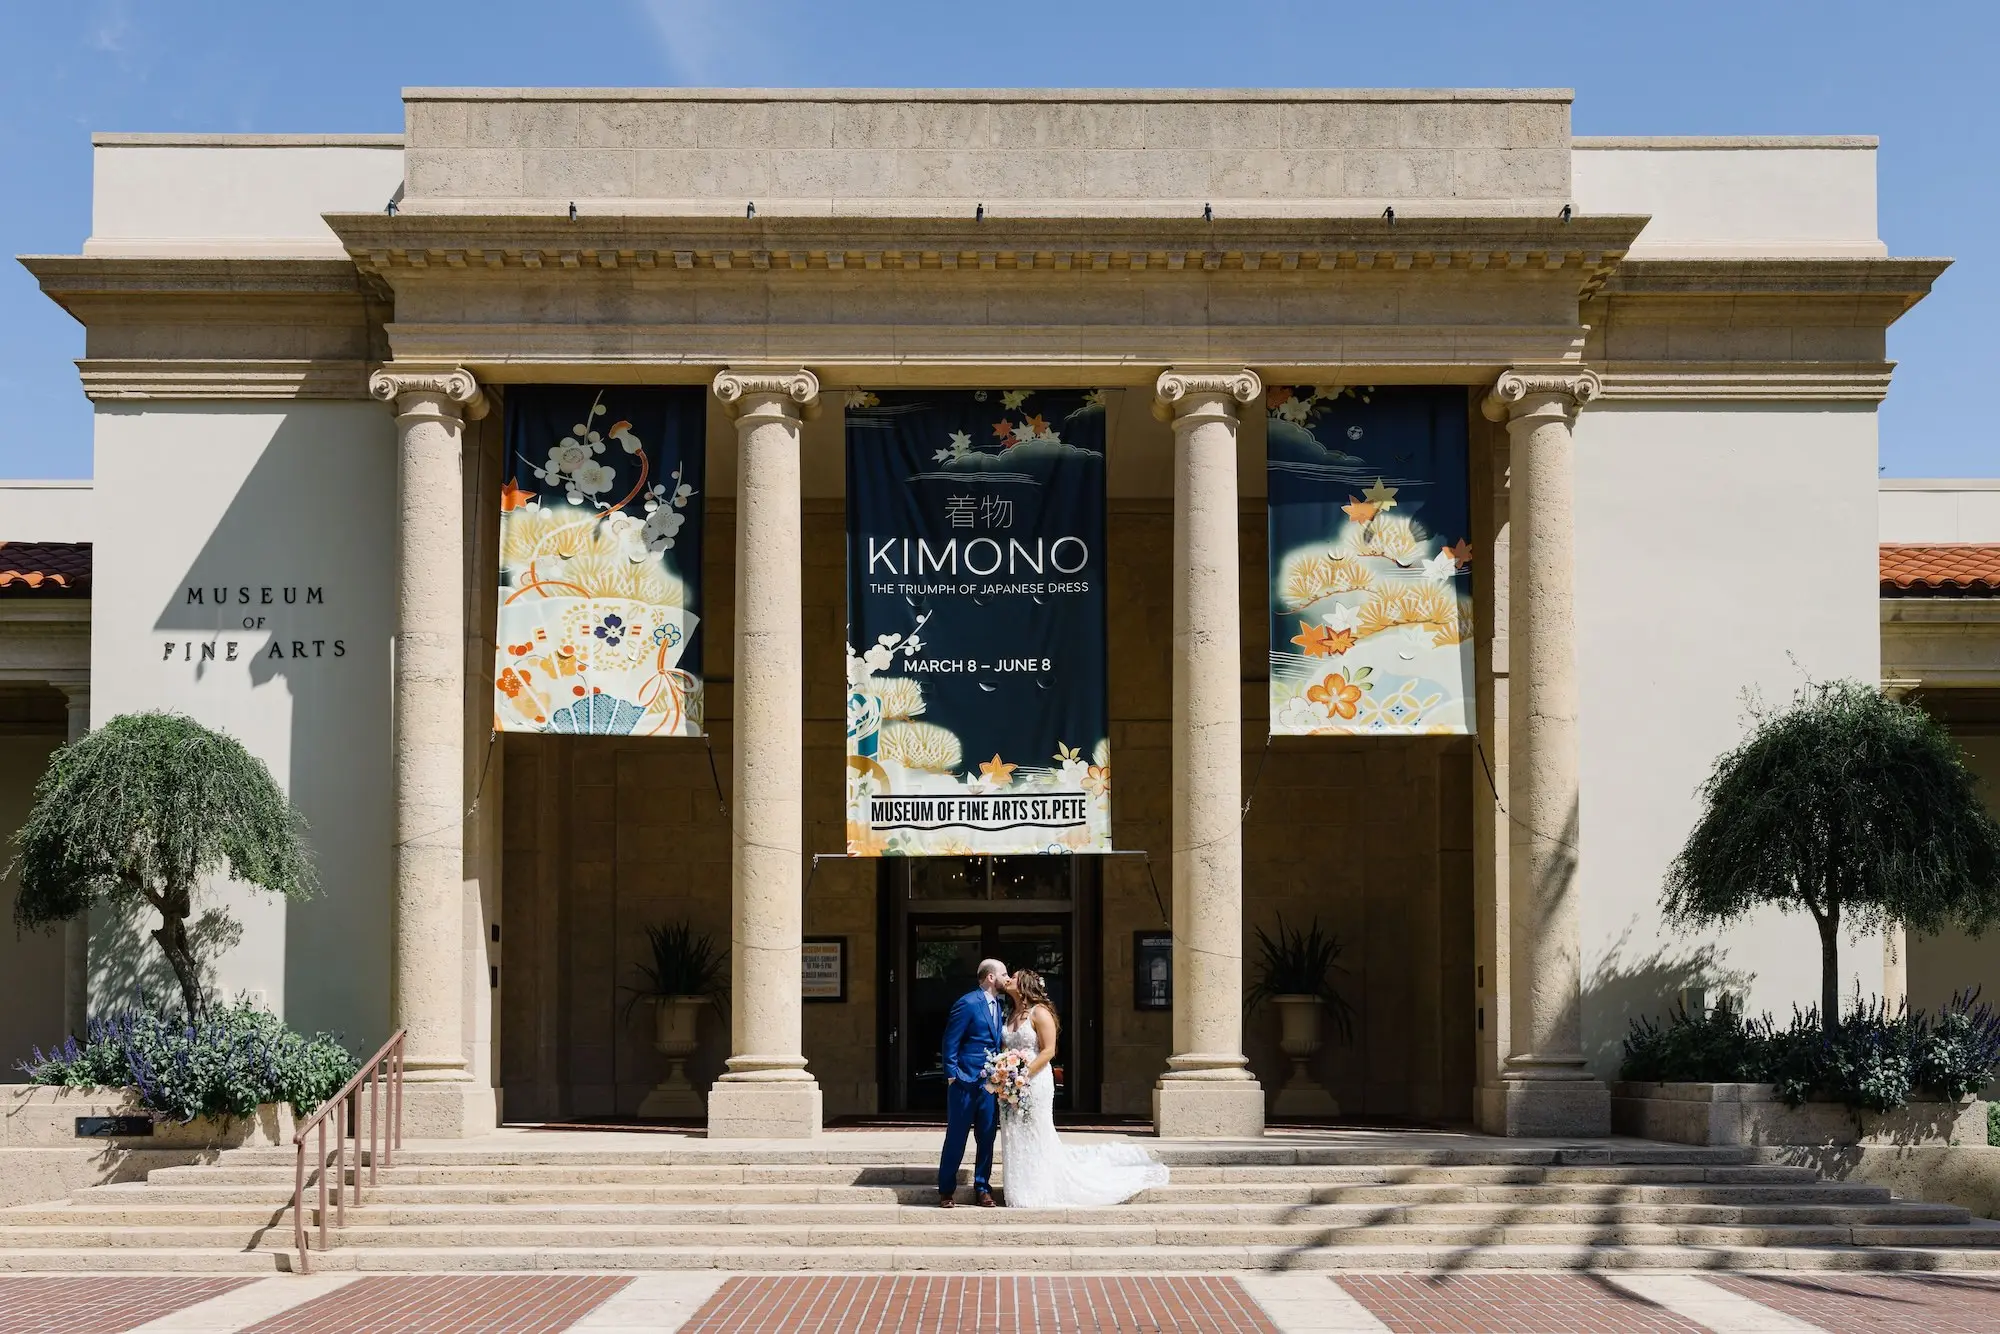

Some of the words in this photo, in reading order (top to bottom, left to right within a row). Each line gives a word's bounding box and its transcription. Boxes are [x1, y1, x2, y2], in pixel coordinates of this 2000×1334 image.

[945, 494, 1013, 529] 着物
[869, 536, 1089, 575] KIMONO
[186, 586, 325, 605] MUSEUM
[870, 584, 894, 594] THE
[898, 584, 956, 595] TRIUMPH
[959, 584, 977, 595] OF
[980, 583, 1044, 595] JAPANESE
[1048, 581, 1089, 593] DRESS
[242, 617, 266, 630] OF
[162, 641, 239, 662] FINE
[267, 639, 346, 659] ARTS
[903, 660, 963, 673] MARCH
[967, 659, 977, 672] 8
[994, 659, 1038, 672] JUNE
[1041, 658, 1051, 671] 8
[871, 800, 933, 822] MUSEUM
[937, 801, 955, 821] OF
[958, 800, 989, 821] FINE
[992, 799, 1028, 821] ARTS
